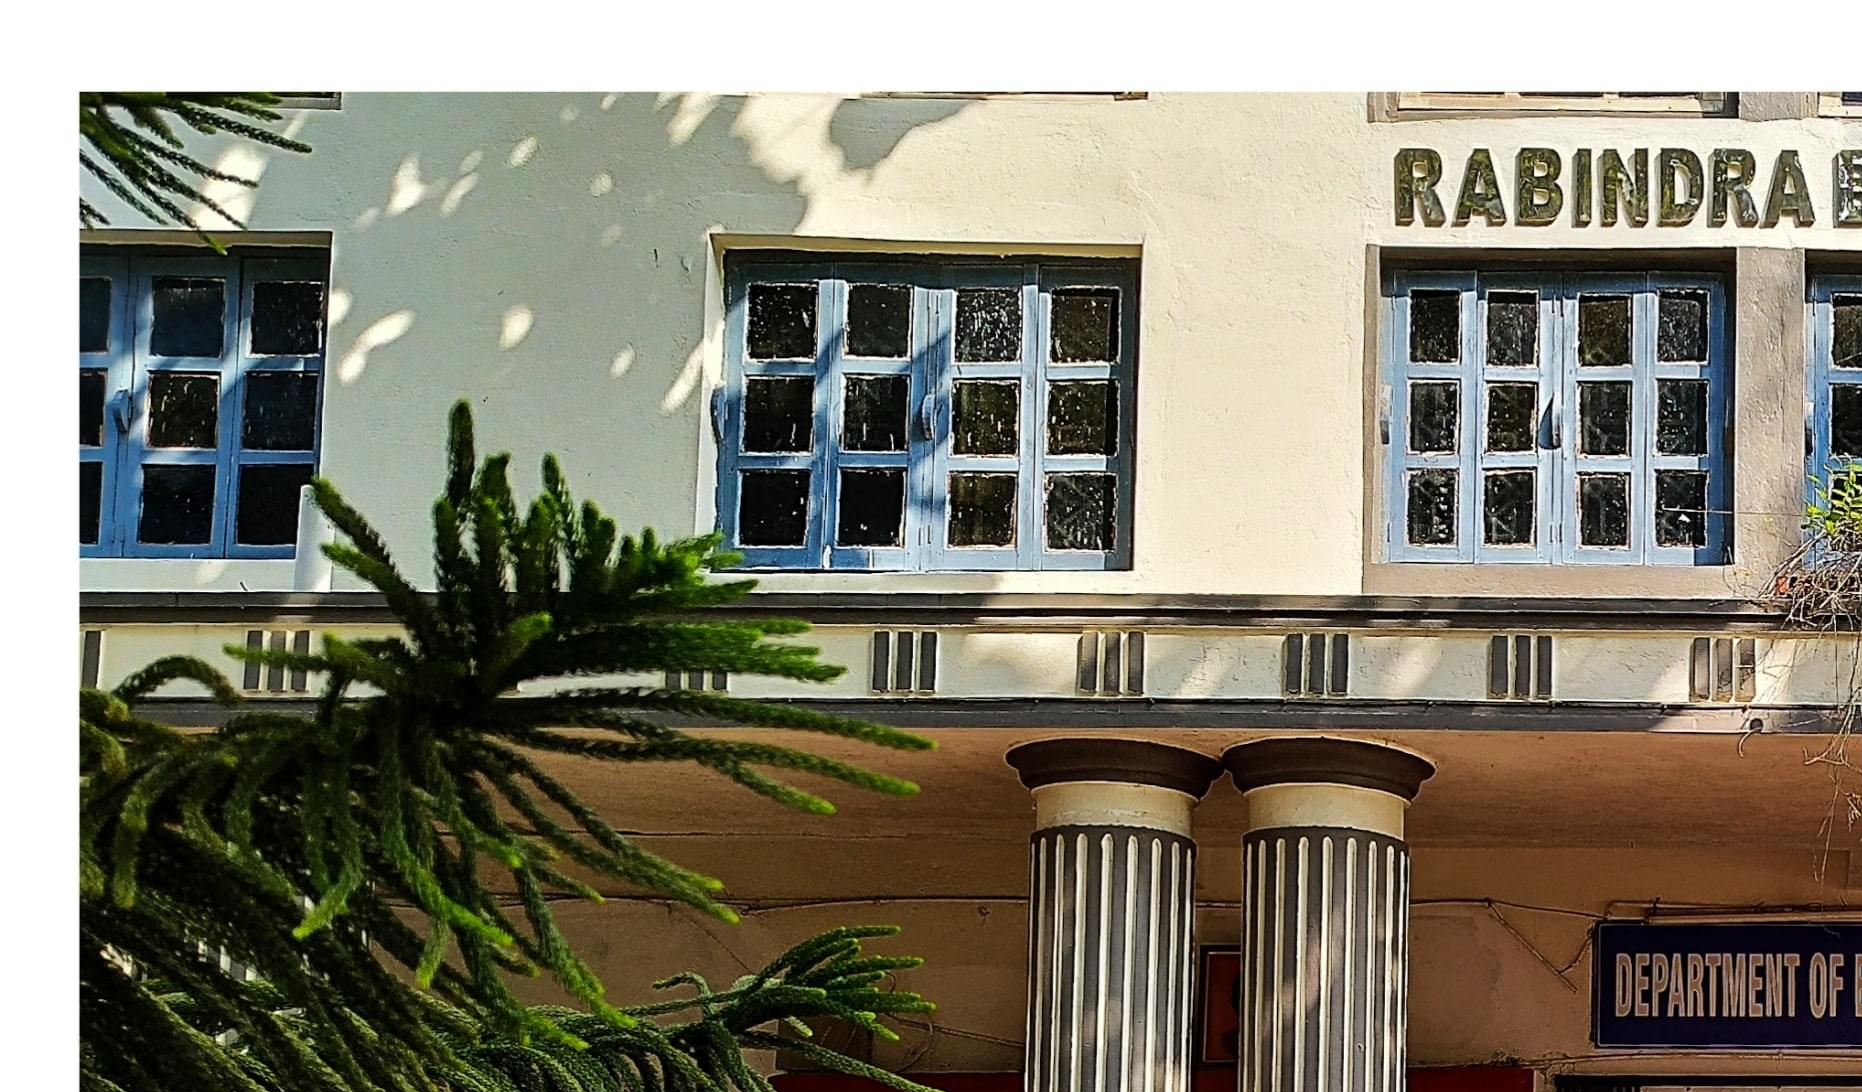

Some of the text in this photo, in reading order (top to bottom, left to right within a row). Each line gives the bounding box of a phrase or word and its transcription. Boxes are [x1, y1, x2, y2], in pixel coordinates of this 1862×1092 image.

[1392, 146, 1816, 229] RABINDRA
[1614, 952, 1801, 1018] DEPARTMENT
[1809, 951, 1845, 1019] OF
